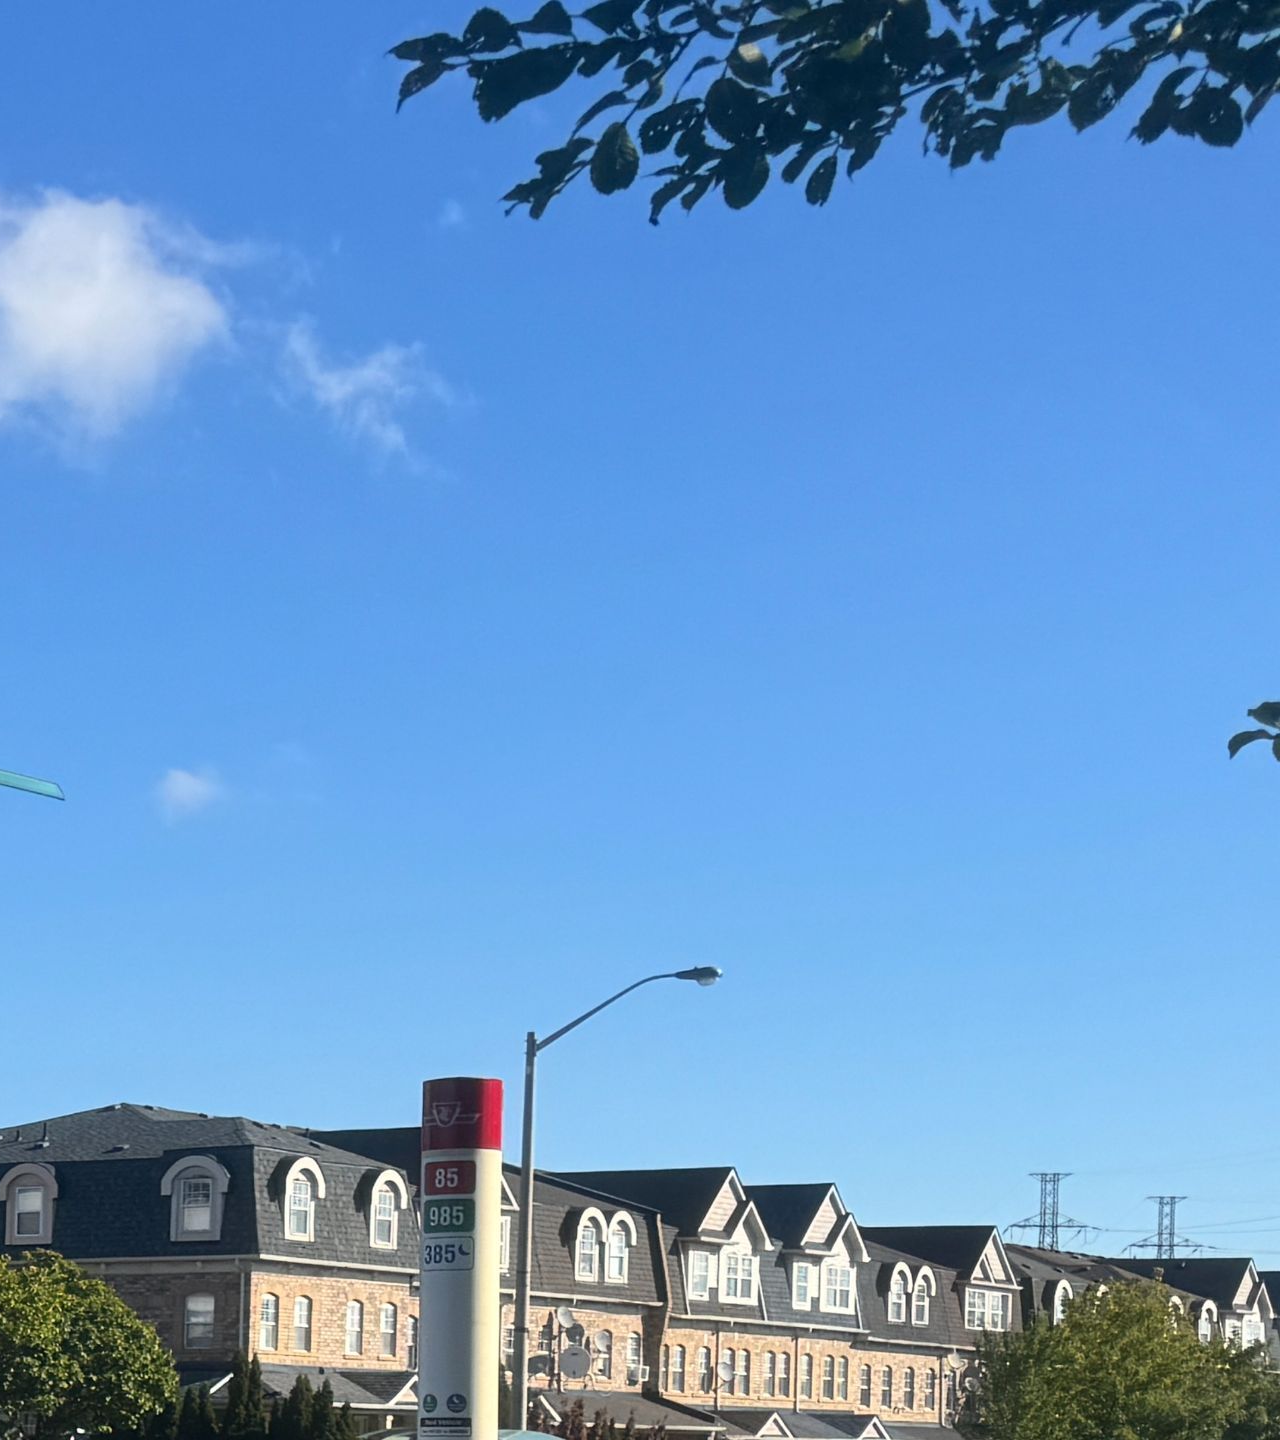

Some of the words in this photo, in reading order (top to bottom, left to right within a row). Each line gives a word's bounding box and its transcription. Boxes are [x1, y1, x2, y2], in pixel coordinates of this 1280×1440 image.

[435, 1168, 459, 1188] 85
[429, 1206, 464, 1226] 985
[425, 1245, 456, 1265] 385
